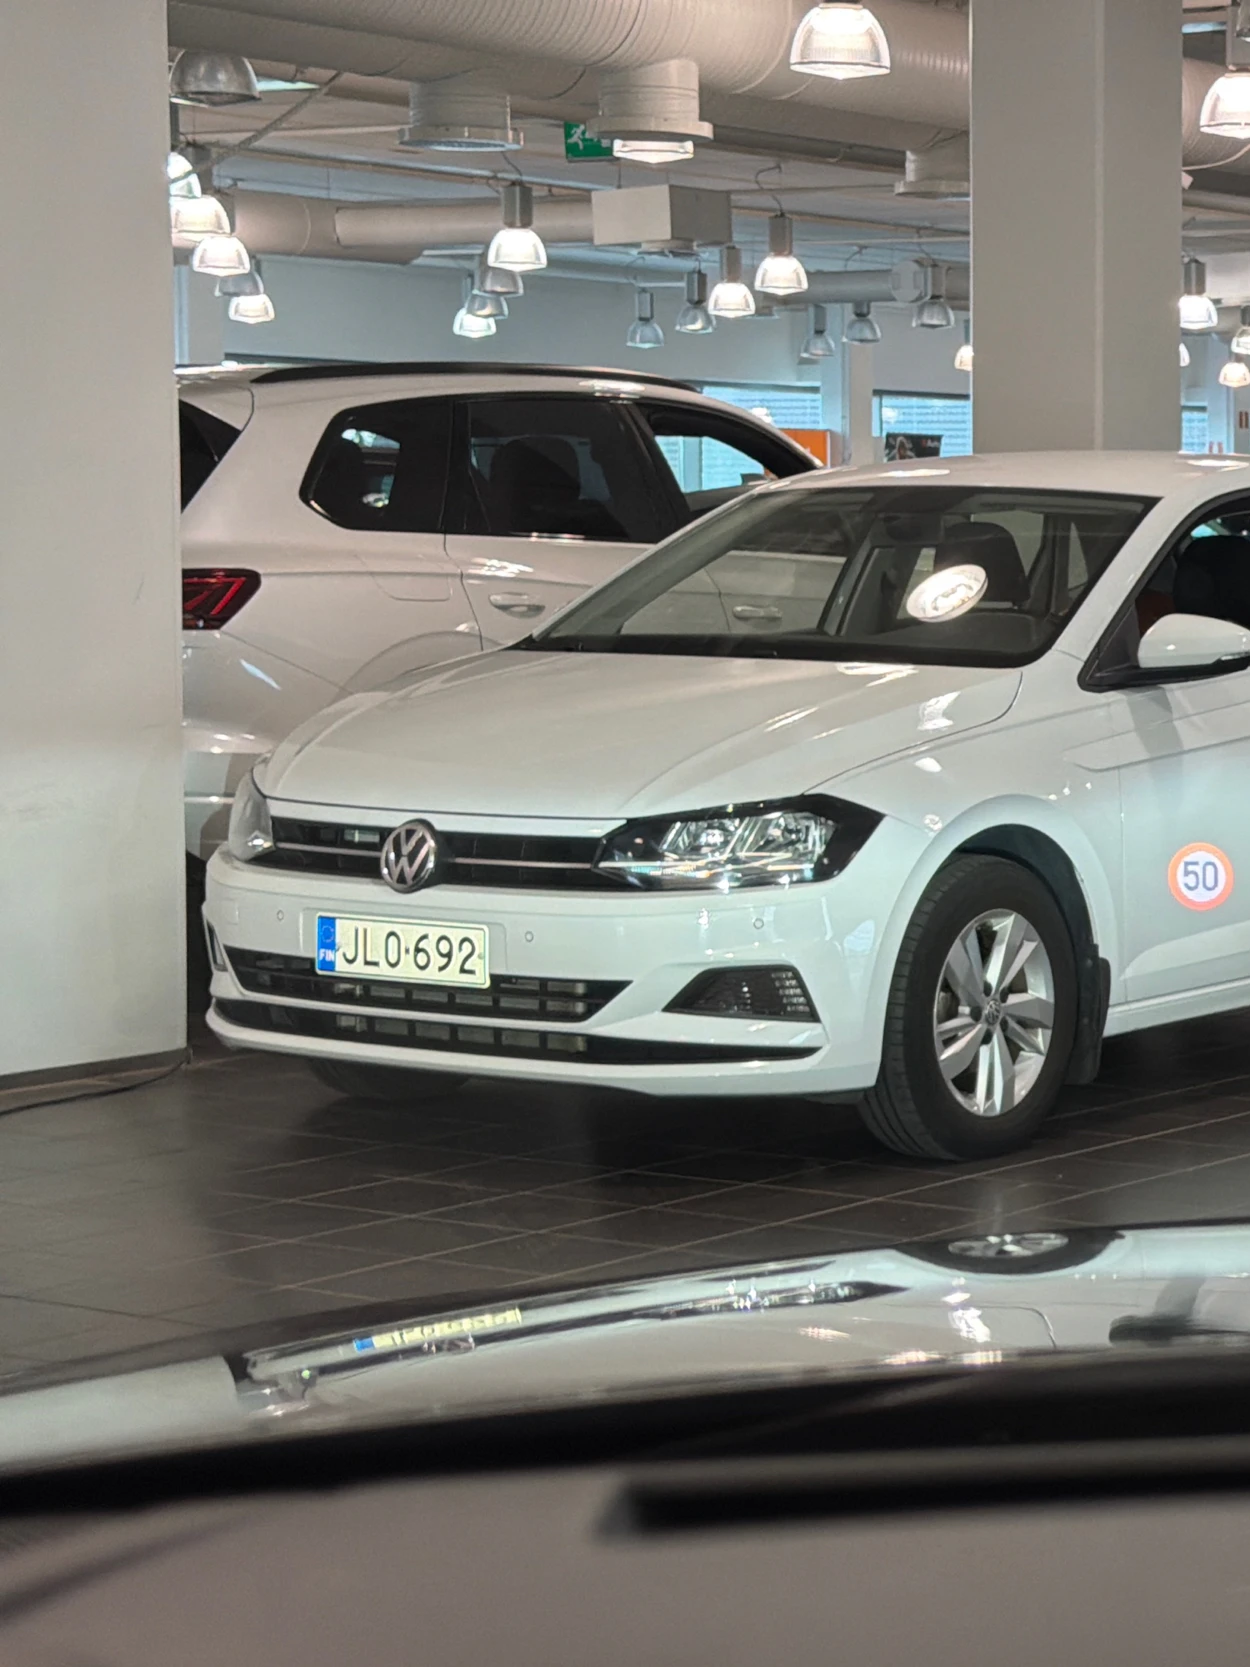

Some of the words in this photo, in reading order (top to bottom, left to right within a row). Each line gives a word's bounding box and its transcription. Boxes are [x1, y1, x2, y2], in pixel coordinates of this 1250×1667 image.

[1183, 861, 1219, 891] 50
[319, 949, 335, 962] FIN
[342, 926, 477, 975] JLO-692
